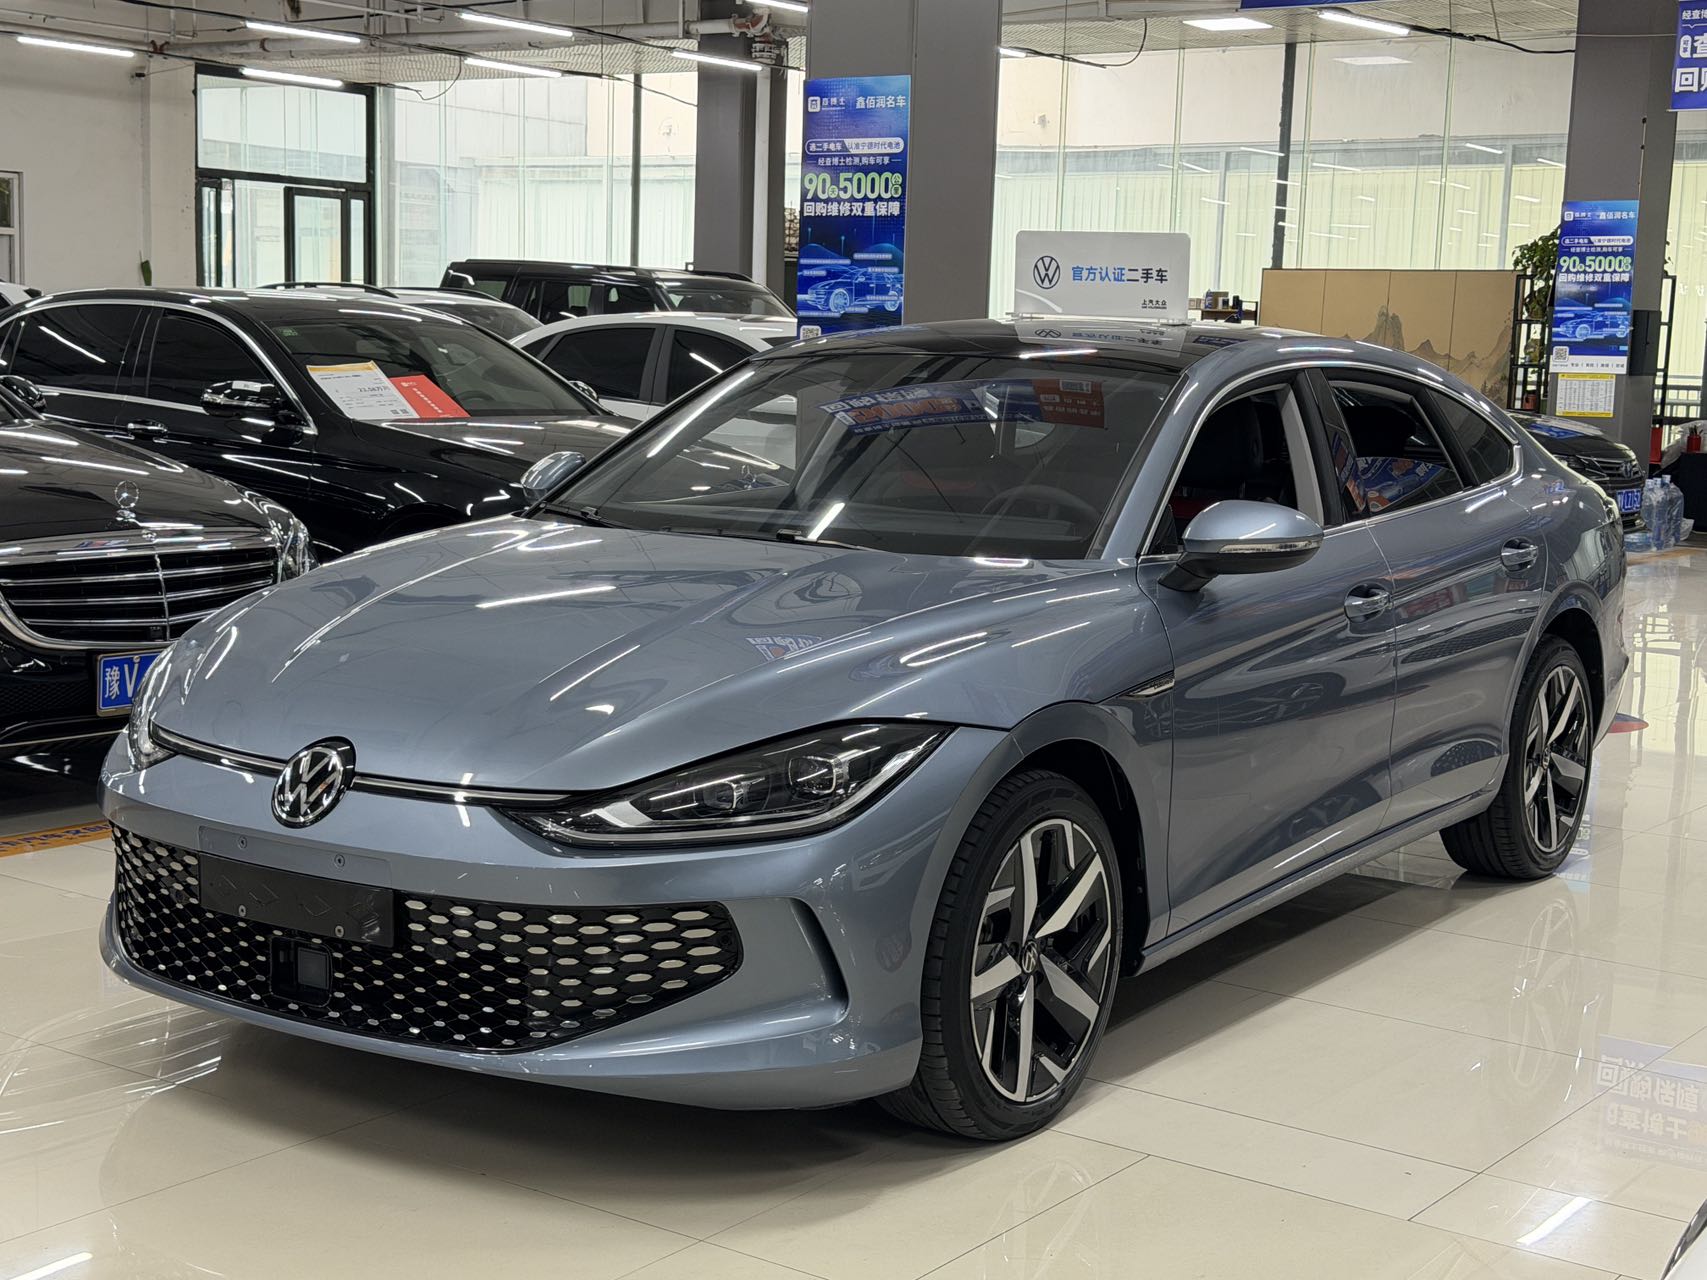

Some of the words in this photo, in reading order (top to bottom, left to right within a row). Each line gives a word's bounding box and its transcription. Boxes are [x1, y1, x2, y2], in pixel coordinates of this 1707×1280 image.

[1675, 67, 1707, 93] 回
[856, 96, 906, 109] 鑫佰润名车
[803, 201, 900, 217] 回购维修双重保障
[1071, 265, 1169, 284] 官方认证二手车
[105, 664, 139, 700] 豫V
